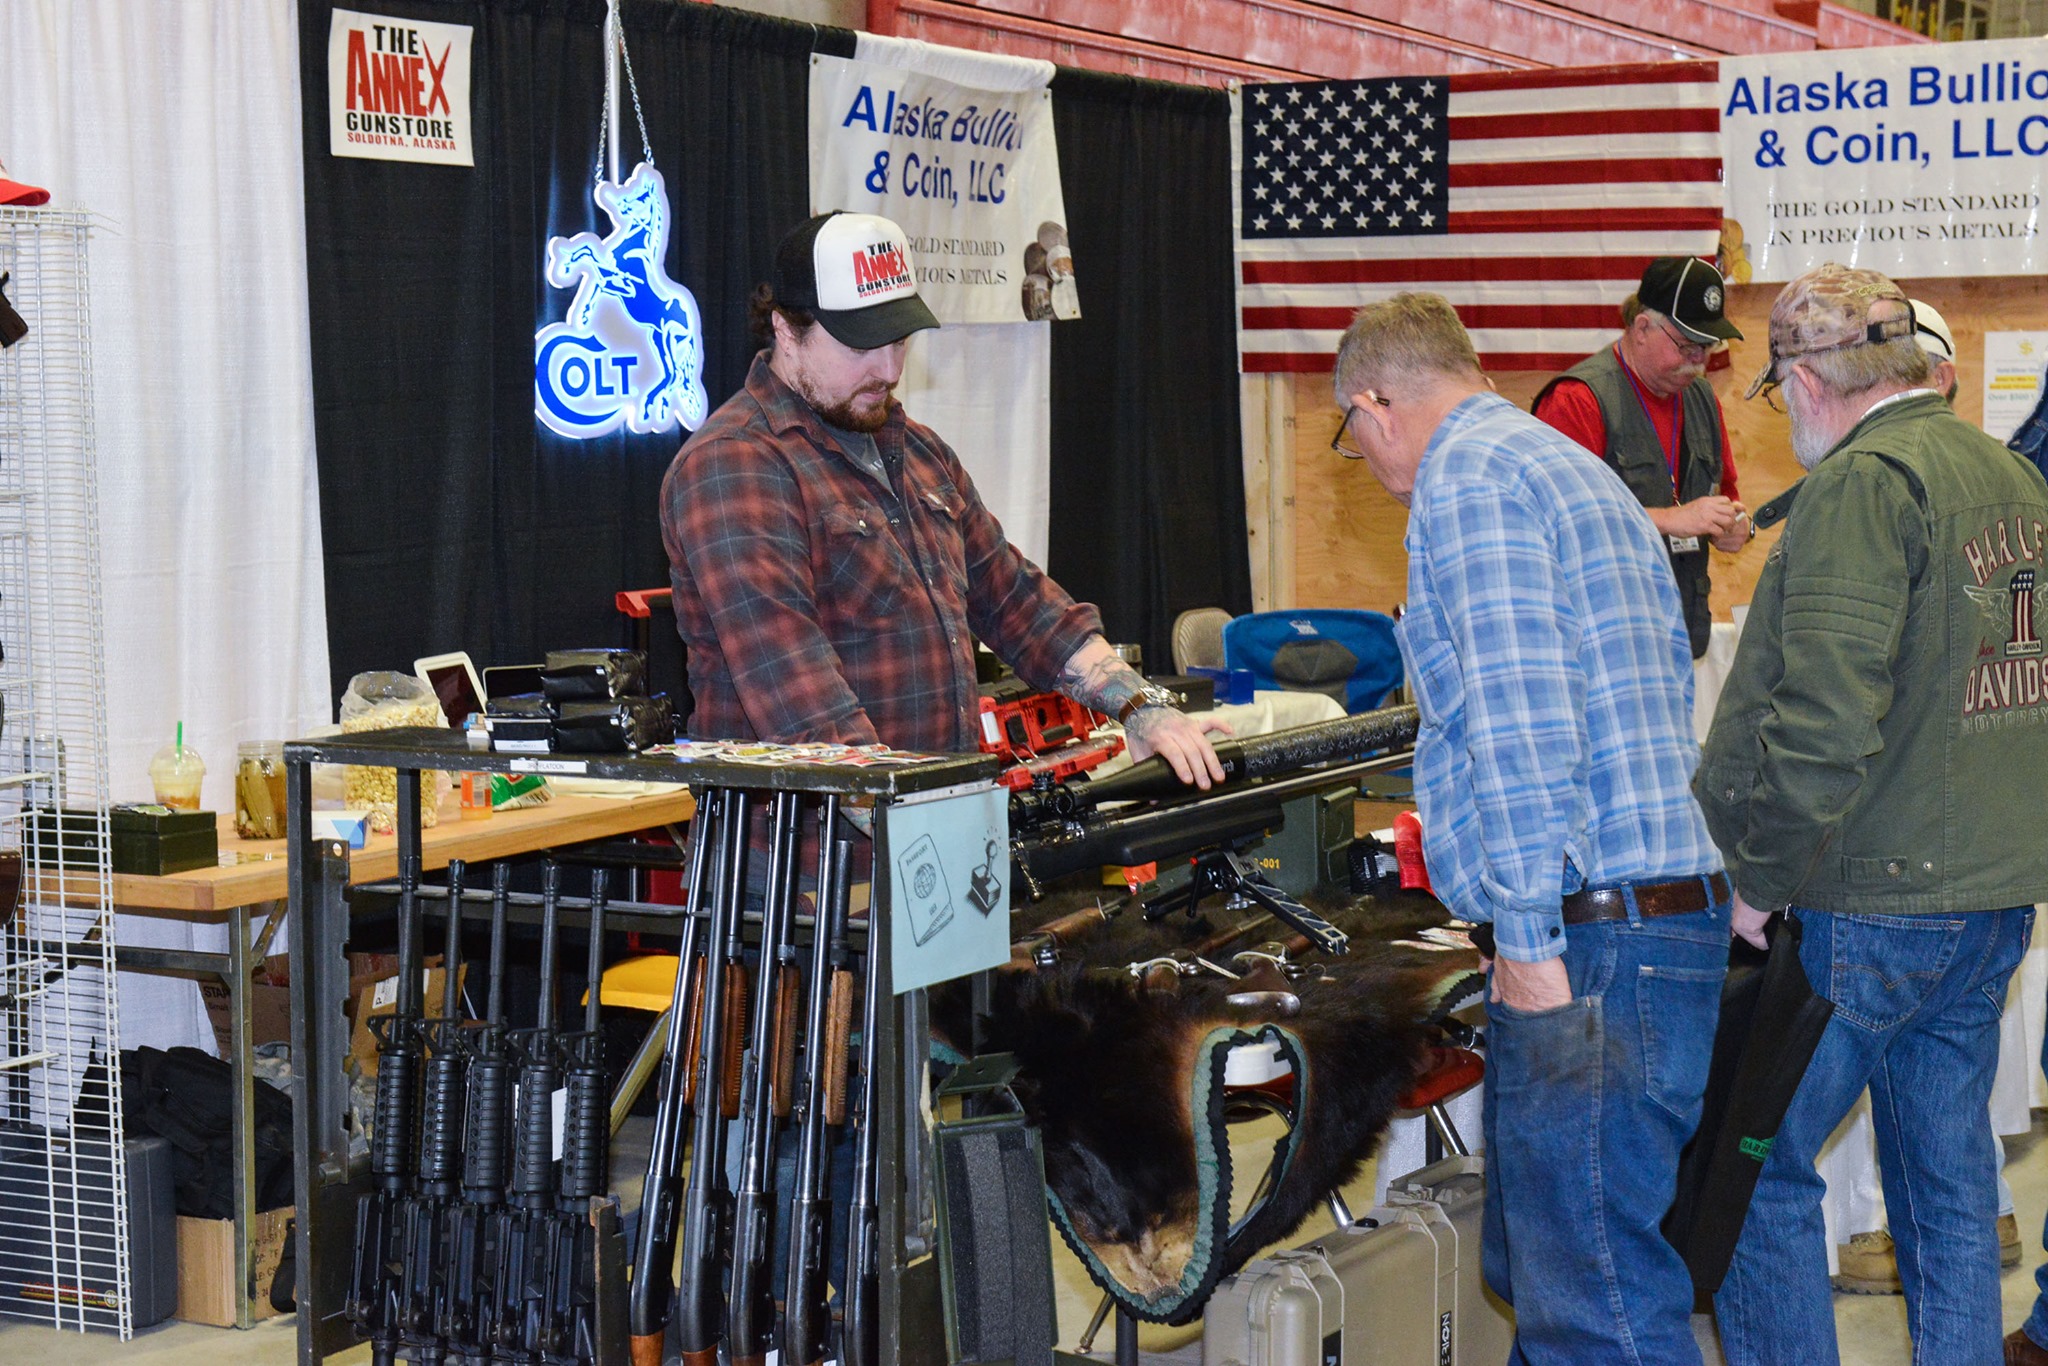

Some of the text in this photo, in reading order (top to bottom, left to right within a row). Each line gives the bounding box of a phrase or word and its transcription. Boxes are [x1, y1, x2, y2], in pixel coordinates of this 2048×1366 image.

[373, 24, 418, 56] THE
[346, 28, 452, 118] ANNEX
[1725, 71, 1888, 117] Alaska
[346, 112, 454, 140] GUNSTORE
[842, 86, 949, 141] Alaska
[347, 132, 456, 151] SOLDOTNA, ALASKA
[1755, 115, 2048, 168] & Coin, LLC
[865, 150, 1005, 208] & Coin, LLC
[1767, 193, 2039, 218] THE GOLD STANDARD
[867, 240, 892, 256] THE
[1770, 221, 2038, 246] IN PRECIOUS METALS
[852, 242, 909, 285] ANNEX
[857, 274, 911, 293] GUNSTORE
[536, 334, 638, 426] COLT
[1963, 515, 2048, 588] HARLE
